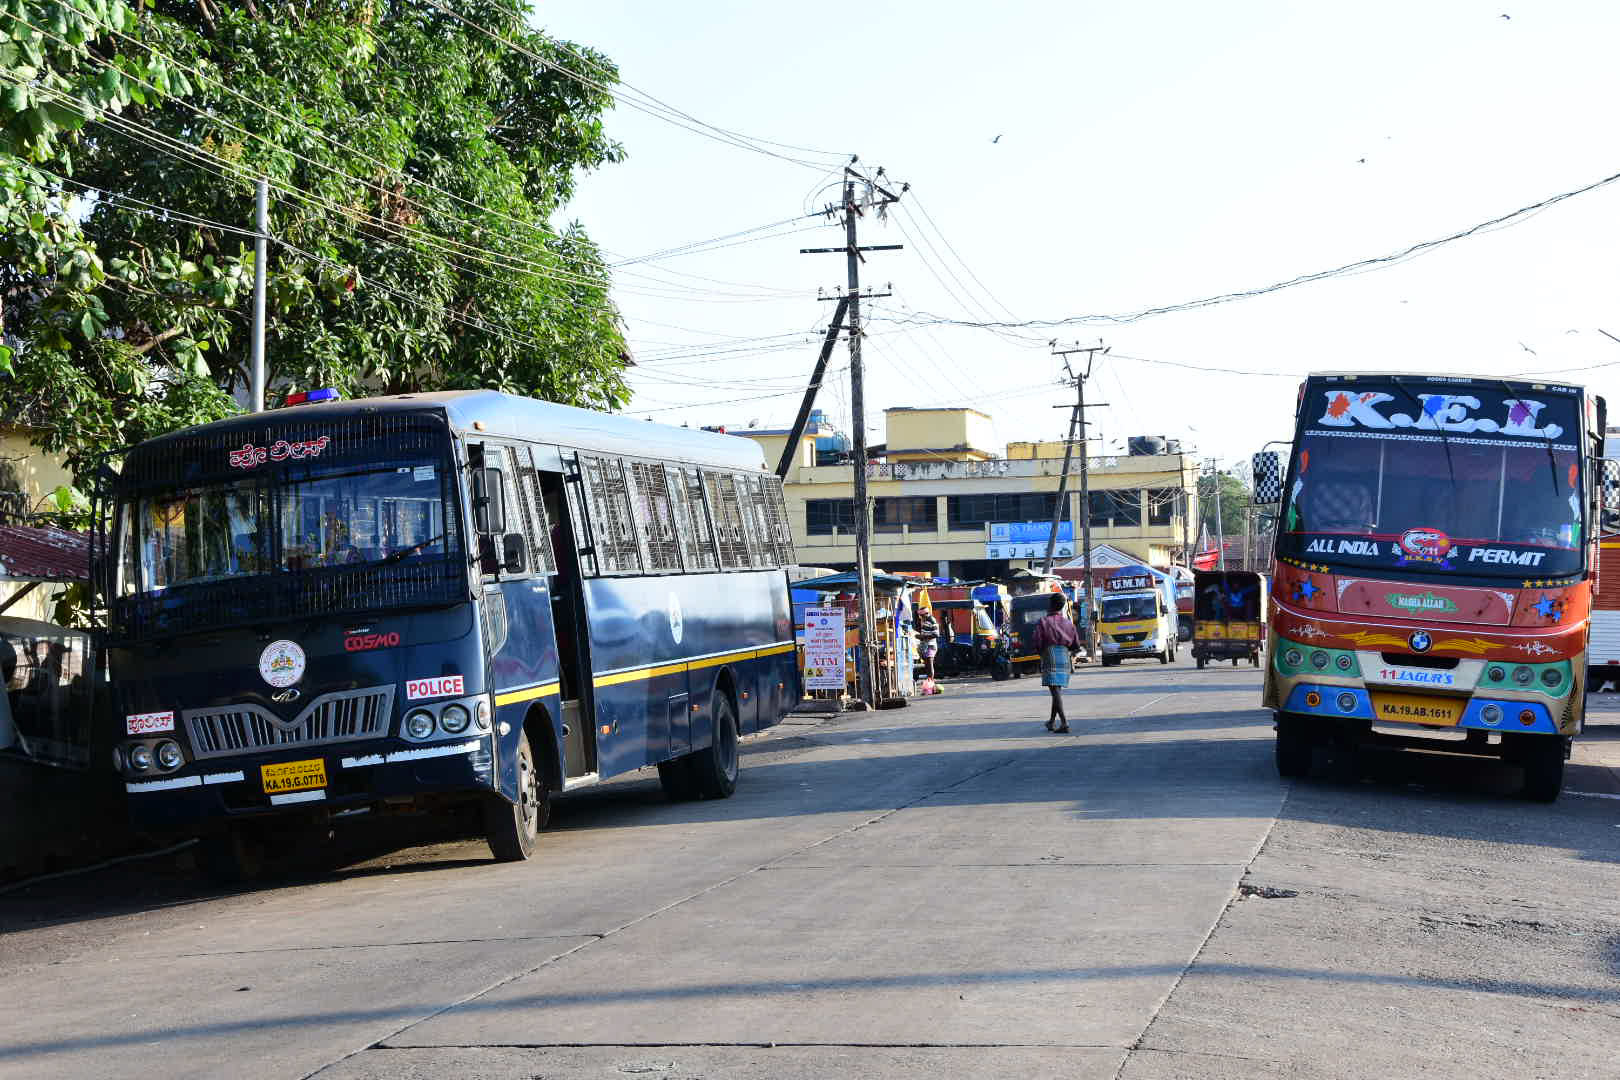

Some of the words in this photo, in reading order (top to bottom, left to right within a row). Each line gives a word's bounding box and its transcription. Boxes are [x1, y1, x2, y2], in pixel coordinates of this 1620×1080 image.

[1306, 539, 1335, 553] ALL
[1337, 540, 1379, 556] INDIA
[1468, 547, 1546, 567] PERMIT
[344, 632, 400, 651] COSMO
[408, 678, 463, 698] POLICE
